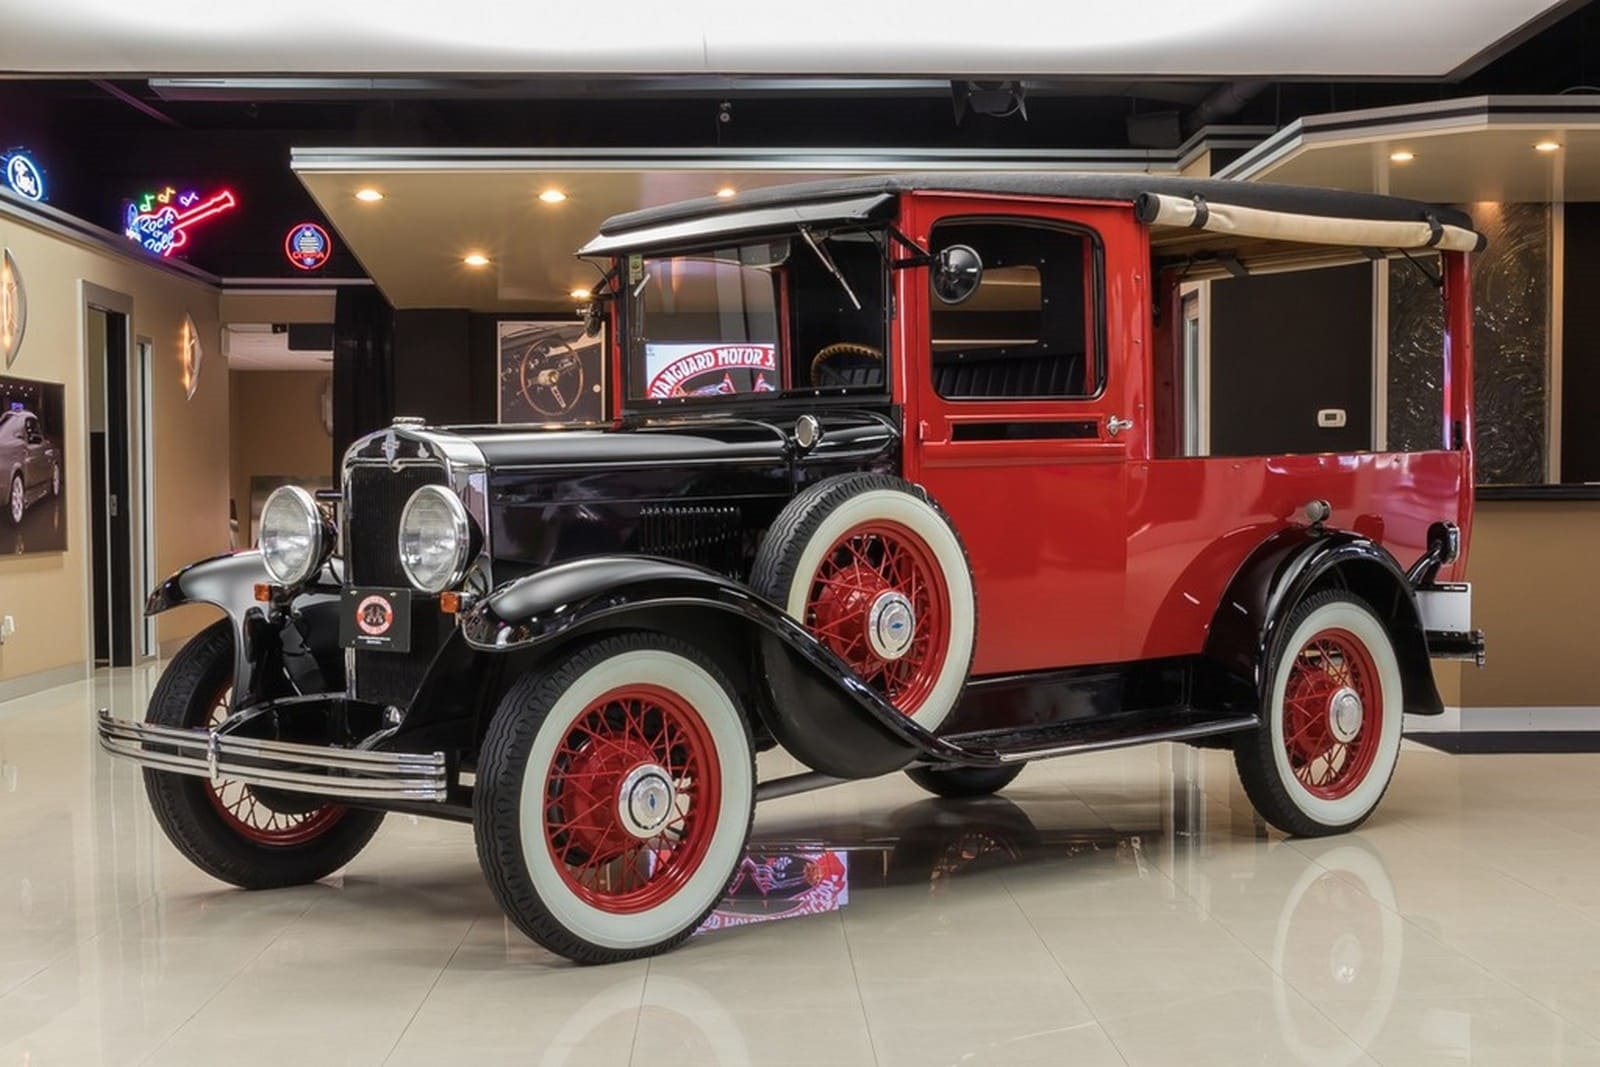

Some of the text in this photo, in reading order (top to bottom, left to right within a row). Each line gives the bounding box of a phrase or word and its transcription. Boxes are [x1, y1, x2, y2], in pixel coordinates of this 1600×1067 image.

[140, 209, 174, 234] Rock
[651, 351, 715, 398] VANGUARD
[717, 348, 763, 365] MOTOR
